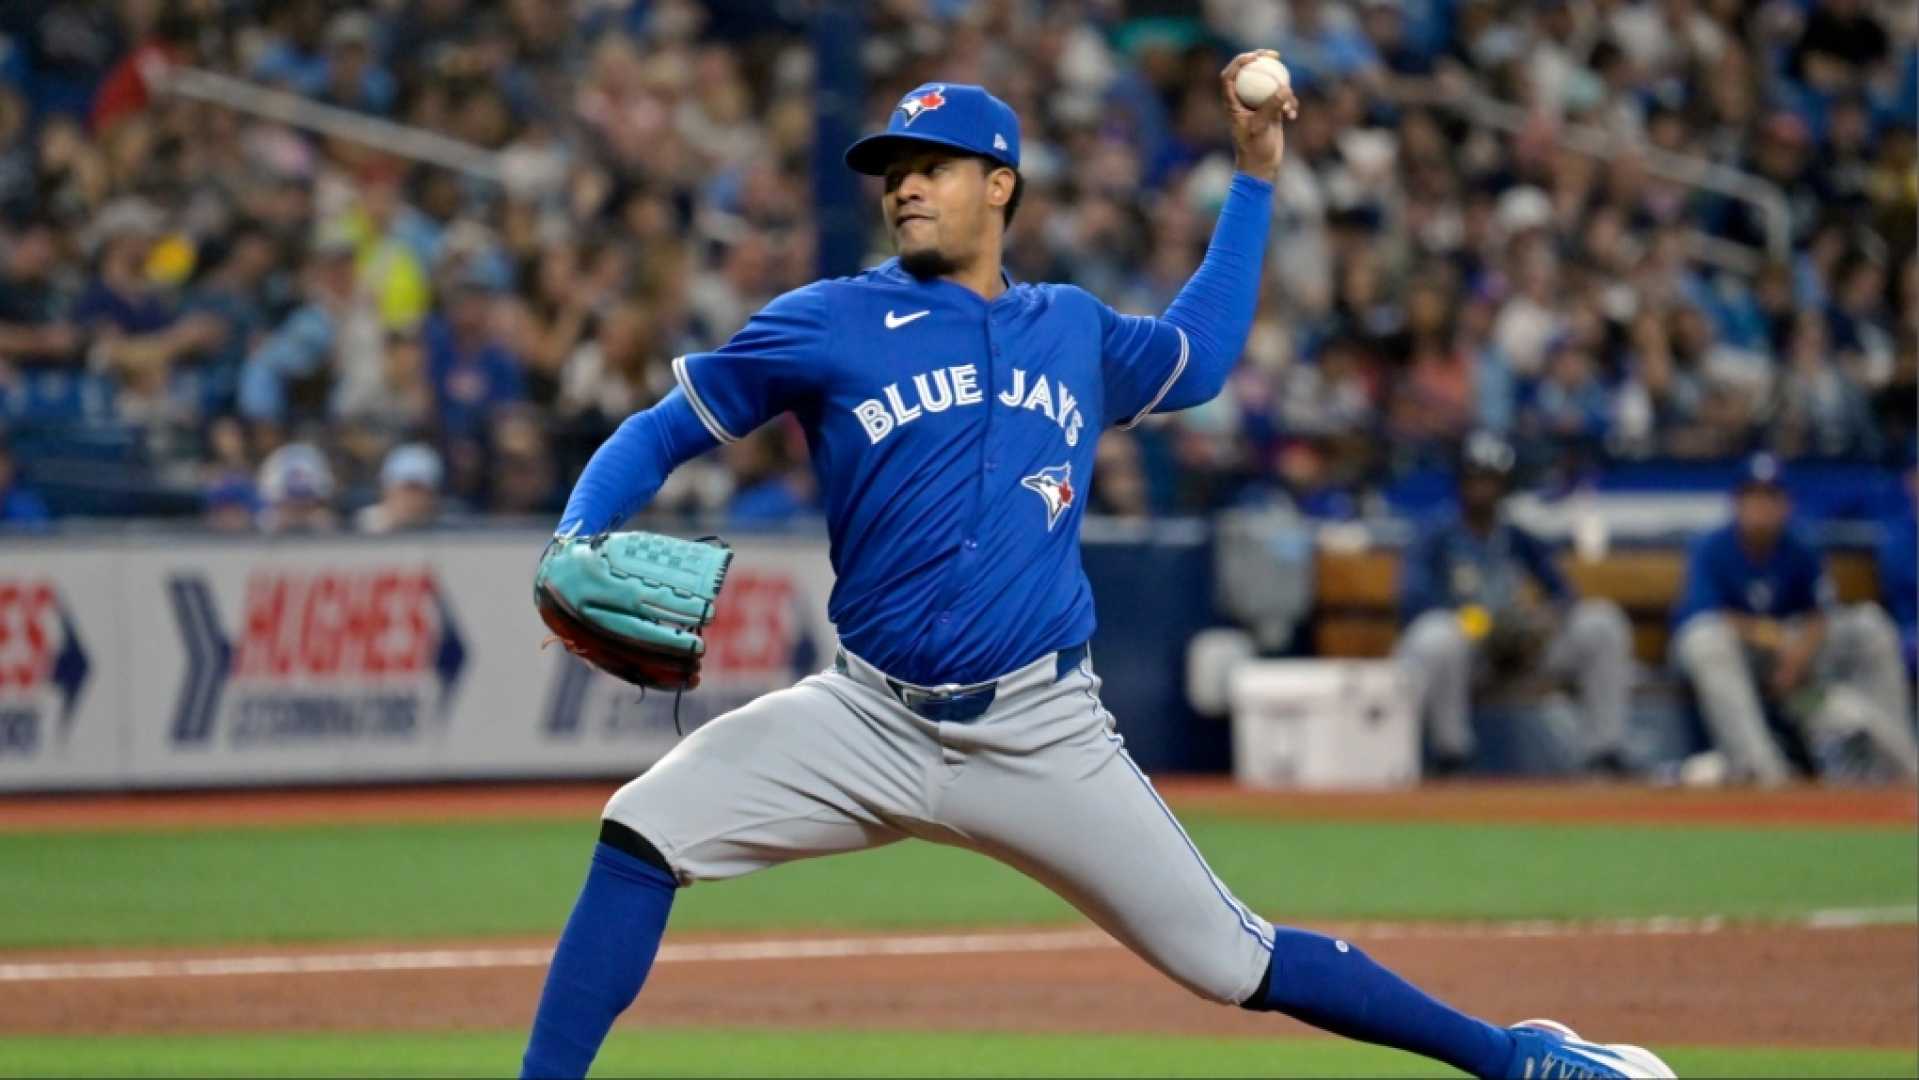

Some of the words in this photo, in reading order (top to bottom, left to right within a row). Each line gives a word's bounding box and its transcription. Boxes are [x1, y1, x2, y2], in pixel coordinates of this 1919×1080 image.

[853, 364, 983, 445] BLUE
[999, 368, 1083, 446] JAYS
[231, 570, 436, 677] HUGHES
